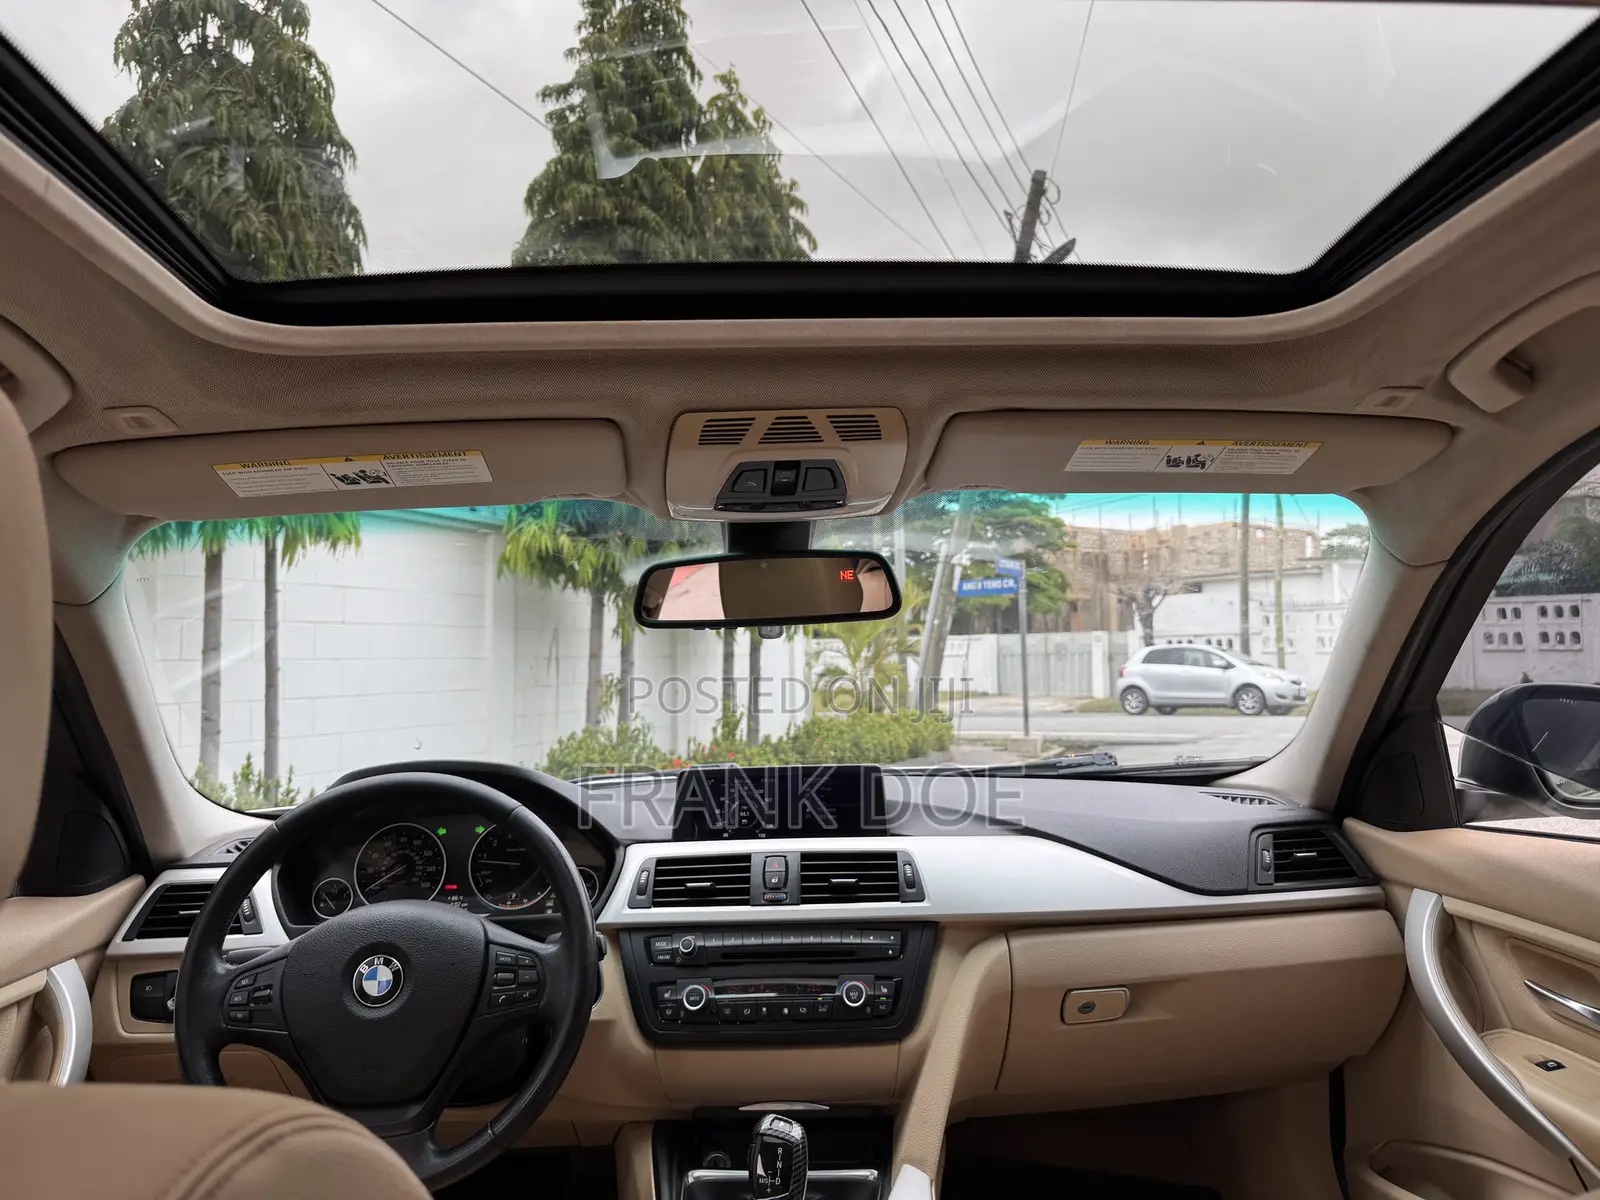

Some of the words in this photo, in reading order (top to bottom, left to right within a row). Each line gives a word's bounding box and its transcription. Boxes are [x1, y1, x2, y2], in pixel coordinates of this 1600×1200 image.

[383, 451, 467, 460] AVERTISSEMENT
[240, 460, 292, 469] WARNING
[840, 570, 854, 580] NE
[360, 957, 399, 974] BMW
[777, 1147, 783, 1155] R
